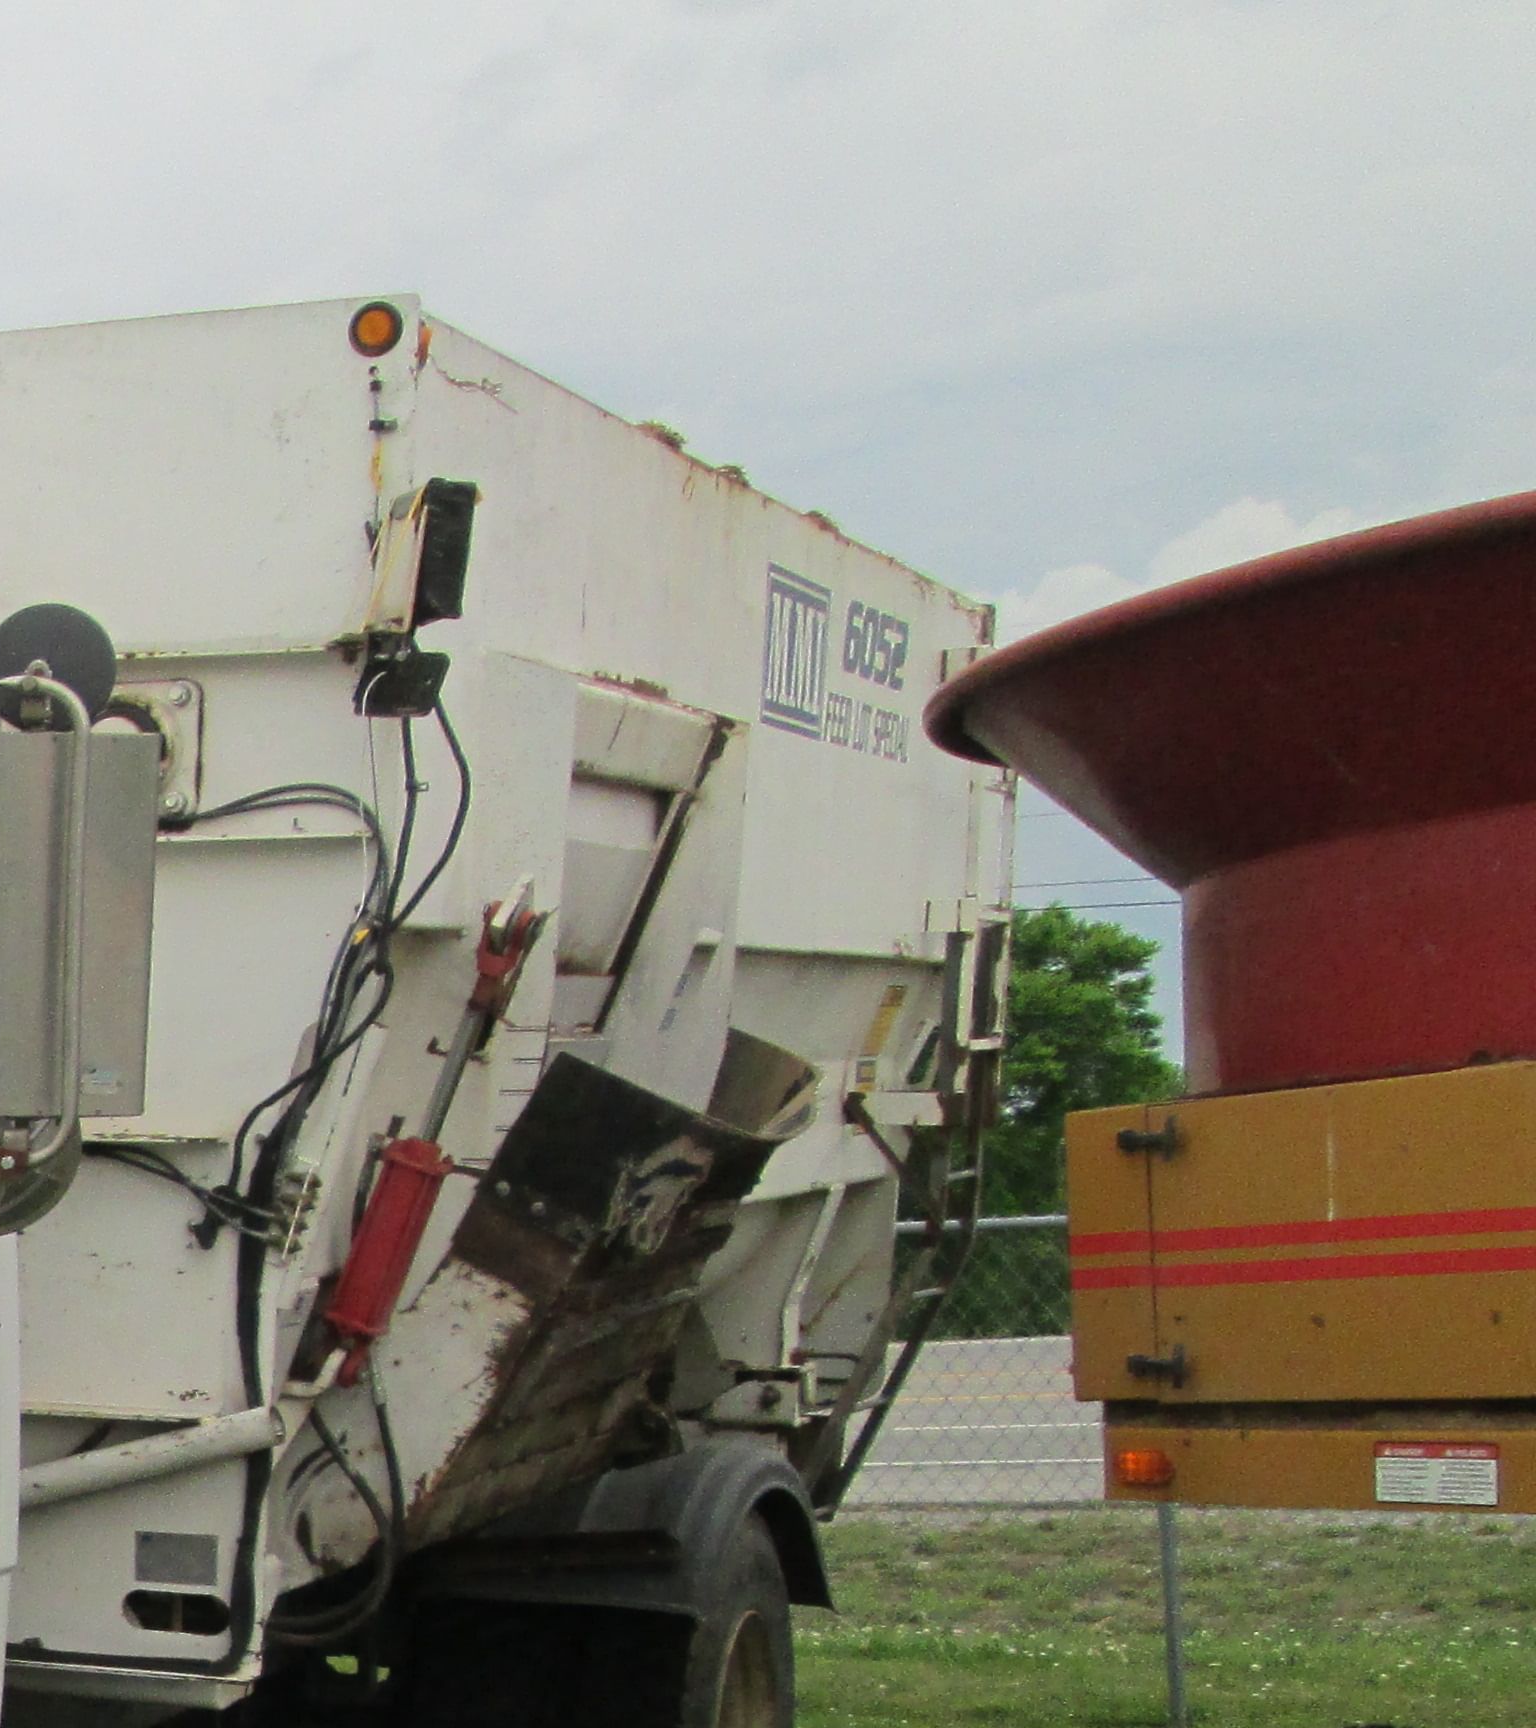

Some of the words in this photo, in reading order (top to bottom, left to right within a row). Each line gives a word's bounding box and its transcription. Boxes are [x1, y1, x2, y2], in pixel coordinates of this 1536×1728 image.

[842, 600, 909, 691] 6052
[825, 691, 852, 747] FEED
[853, 700, 872, 753] LOT
[873, 708, 910, 764] SPECIAL
